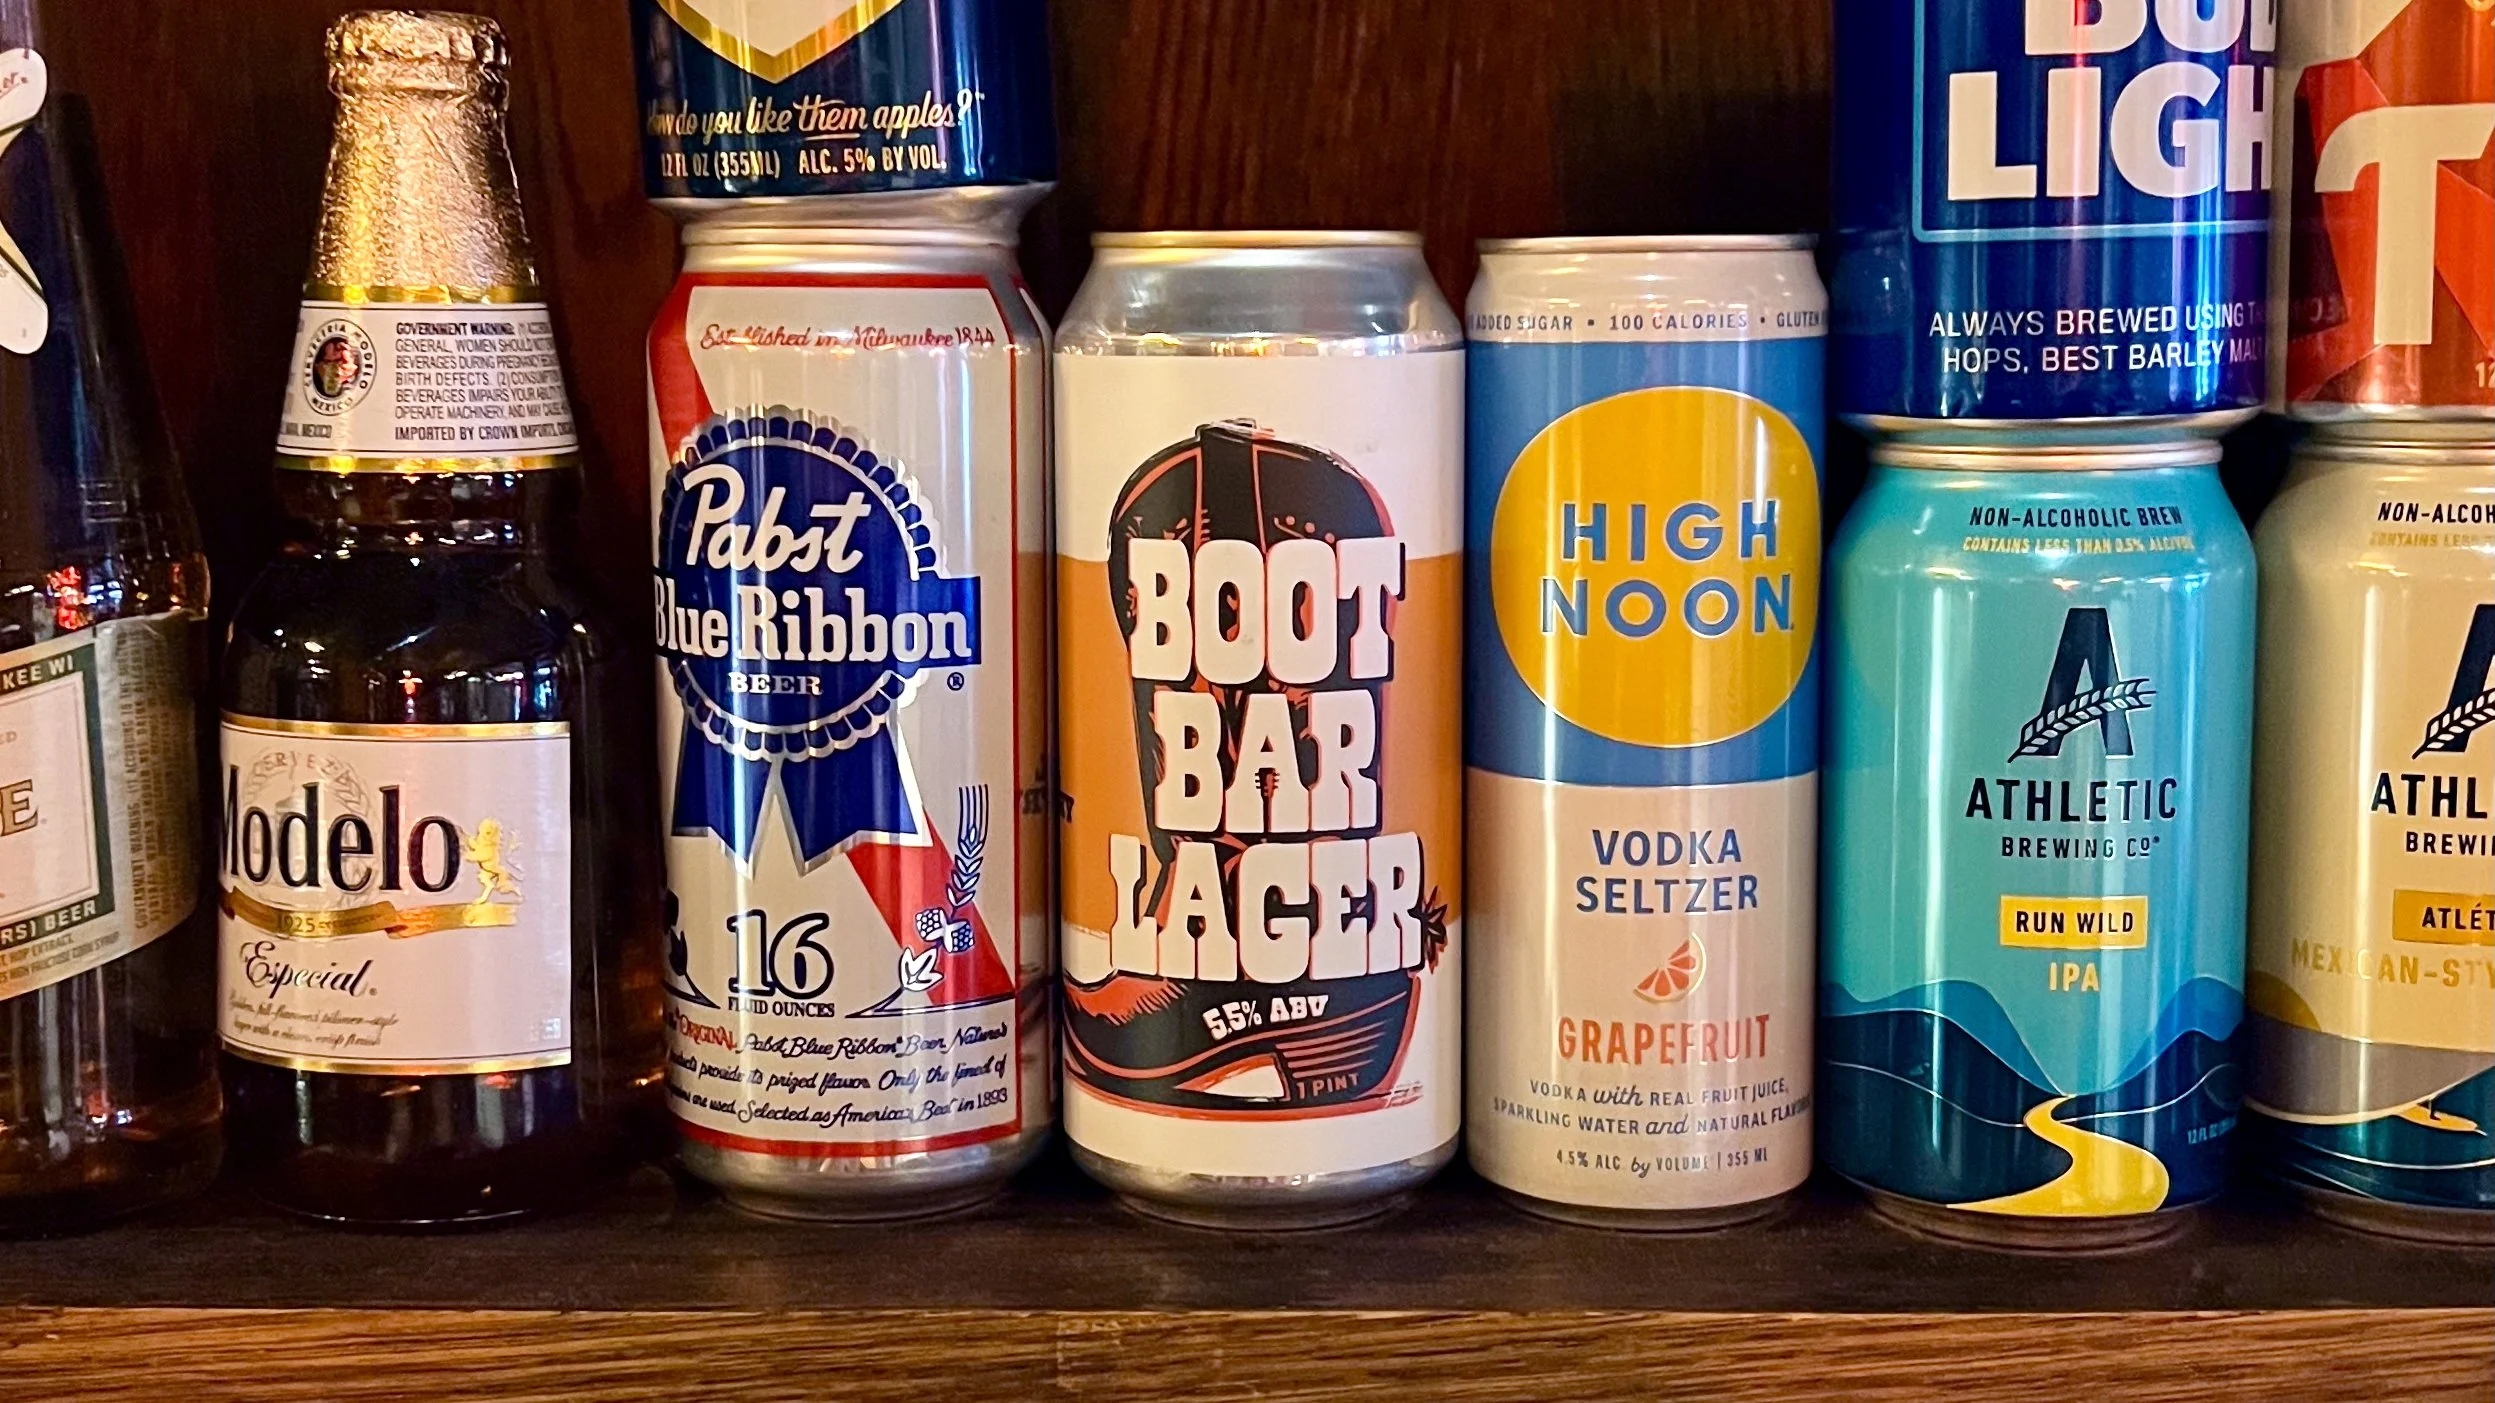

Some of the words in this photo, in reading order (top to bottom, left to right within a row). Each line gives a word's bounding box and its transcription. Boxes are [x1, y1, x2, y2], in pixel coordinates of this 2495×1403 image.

[676, 98, 698, 136] do
[701, 111, 743, 146] you
[746, 96, 793, 135] like
[793, 93, 868, 136] them
[674, 153, 688, 177] FL
[692, 152, 710, 177] OZ
[714, 149, 781, 181] (355ML)
[799, 149, 839, 175] ALC.
[844, 147, 876, 173] 5%
[881, 145, 904, 171] BY
[908, 144, 948, 170] VOL.
[396, 322, 467, 335] GOVERNMENT
[1475, 313, 1512, 331] ADDED
[1517, 314, 1573, 331] SUGAR
[1608, 314, 1644, 331] 100
[1651, 312, 1748, 331] CALORIES
[1929, 311, 2045, 337] ALWAYS
[2055, 306, 2178, 336] BREWED
[2184, 302, 2245, 331] USING
[456, 338, 497, 352] WOMEN
[844, 325, 954, 351] Milwaukee
[954, 326, 997, 345] 1844
[396, 354, 456, 369] BEVERAGES
[459, 354, 496, 369] DURING
[1943, 346, 2029, 374] HOPS,
[2042, 344, 2119, 372] BEST
[2128, 340, 2224, 370] BARLEY
[396, 371, 431, 386] BIRTH
[396, 388, 466, 403] BEVERAGES
[395, 405, 444, 420] OPERATE
[395, 426, 456, 440] IMPORTED
[460, 426, 475, 440] BY
[478, 425, 519, 440] CROWN
[682, 463, 871, 574] Pabst
[1562, 499, 1778, 561] HIGH
[1969, 507, 2131, 528] NON-ALCOHOLIC
[2136, 505, 2183, 526] BREW
[1963, 536, 2030, 554] CONTAINS
[2035, 538, 2070, 554] LESS
[2075, 537, 2112, 554] THAN
[2369, 531, 2438, 548] CONTAINS
[654, 574, 729, 659] Blue
[736, 584, 972, 663] Ribbon
[1127, 537, 1405, 685] BOOT
[1541, 572, 1792, 639] NOON
[50, 655, 74, 676] WI
[728, 672, 823, 695] BEER
[1153, 689, 1383, 834] BAR
[1965, 777, 2178, 822] ATHLETIC
[1592, 829, 1743, 867] VODKA
[2001, 836, 2115, 859] BREWING
[2406, 831, 2495, 857] BREWI
[1110, 831, 1425, 984] LAGER
[1575, 874, 1759, 915] SELTZER
[45, 899, 96, 930] BEER
[2016, 910, 2065, 934] RUN
[2077, 911, 2133, 934] WILD
[240, 940, 373, 999] Especial
[726, 909, 835, 1000] 16
[2049, 962, 2100, 992] IPA
[772, 1001, 835, 1018] OUNCES
[1202, 1000, 1262, 1041] 5.5%
[1270, 994, 1330, 1024] ABV
[735, 1033, 790, 1058] Pabst
[783, 1036, 834, 1058] Blue
[827, 1037, 897, 1059] Ribbon
[1557, 1013, 1770, 1065] GRAPEFRUIT
[699, 1061, 746, 1083] provide
[766, 1072, 816, 1094] prized
[878, 1069, 922, 1094] Only
[925, 1064, 948, 1084] the
[1312, 1072, 1360, 1098] PINT
[738, 1099, 810, 1123] Selected
[810, 1111, 830, 1122] as
[911, 1098, 956, 1124] Best
[957, 1097, 974, 1112] in
[977, 1087, 1008, 1109] 1893
[1530, 1079, 1587, 1103] VODKA
[1592, 1084, 1644, 1107] with
[1650, 1090, 1695, 1107] REAL
[1701, 1086, 1747, 1104] FRUIT
[1493, 1097, 1572, 1129] SPARKLING
[1578, 1115, 1640, 1135] WATER
[1645, 1113, 1691, 1136] and
[1696, 1108, 1767, 1134] NATURAL
[1556, 1149, 1589, 1168] 4.5%
[1631, 1158, 1651, 1179] by
[1656, 1155, 1709, 1172] VOLUME
[1727, 1150, 1749, 1168] 355
